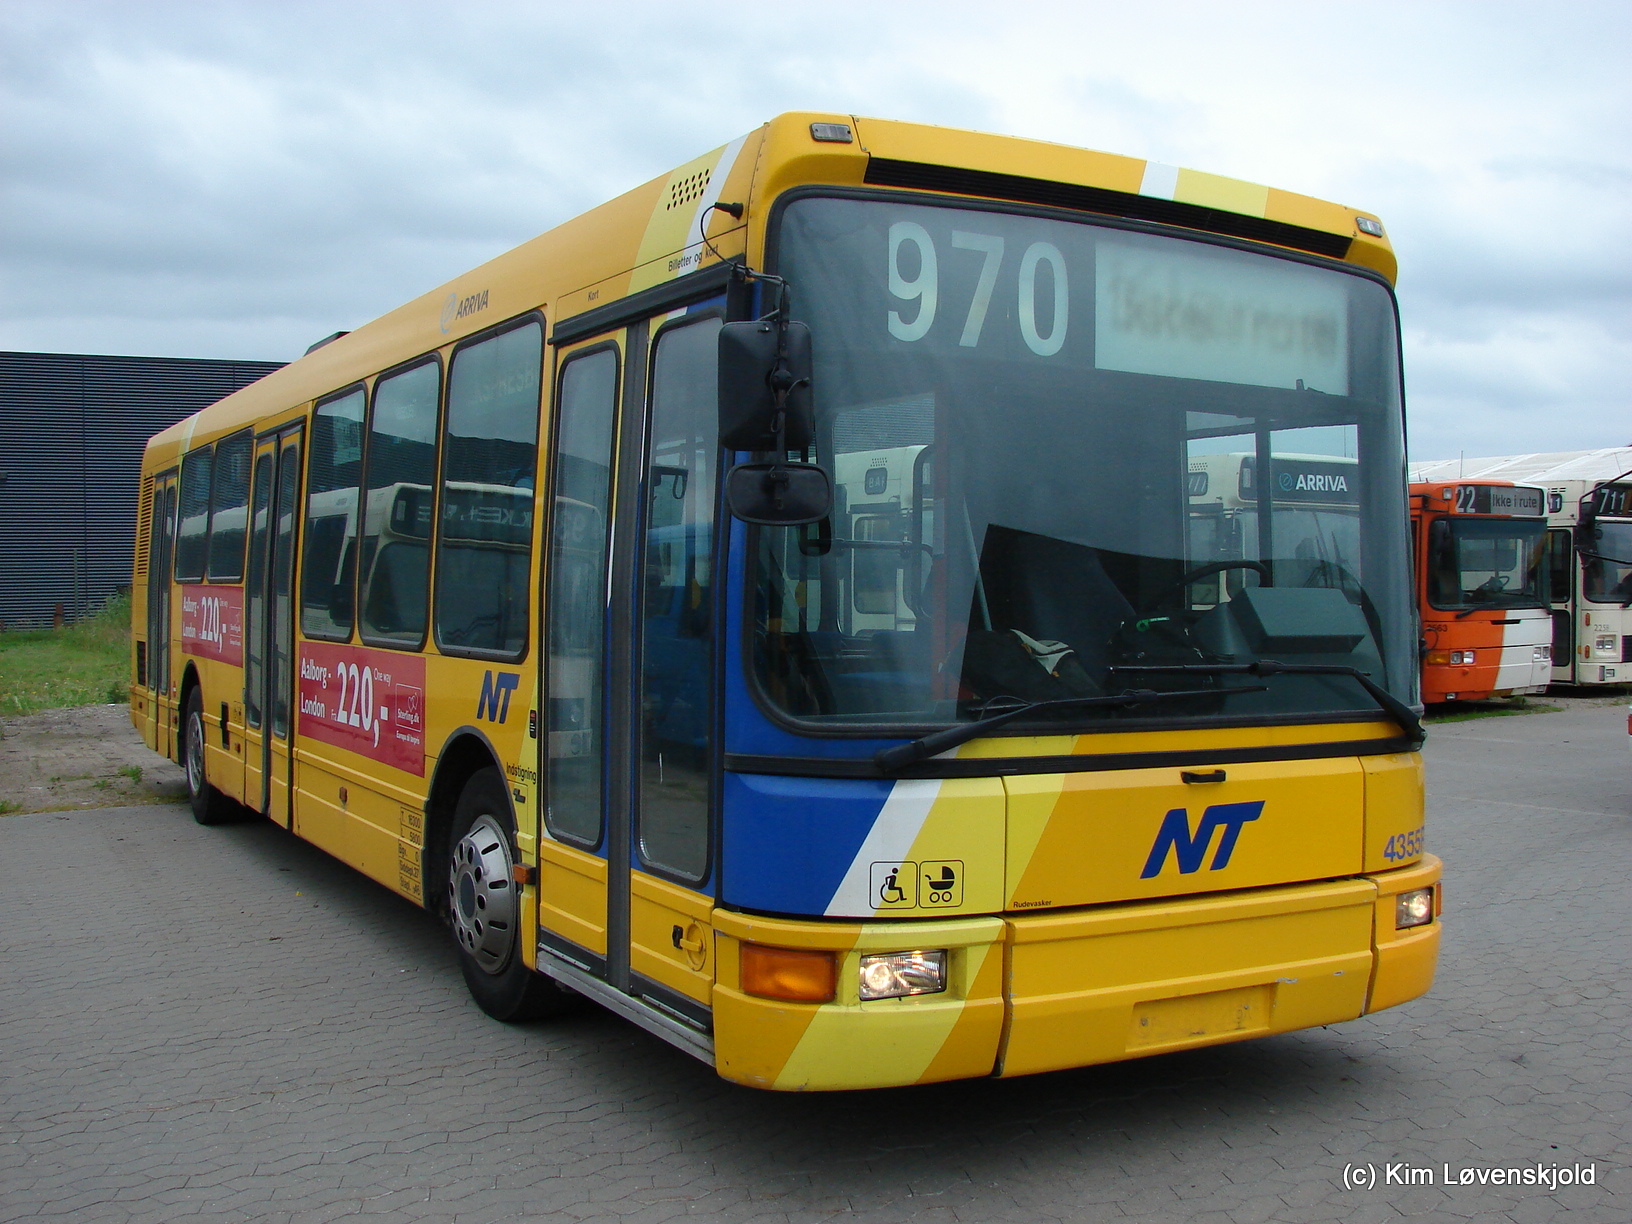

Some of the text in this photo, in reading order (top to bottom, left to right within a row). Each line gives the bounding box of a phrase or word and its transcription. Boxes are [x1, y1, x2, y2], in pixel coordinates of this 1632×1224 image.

[668, 255, 692, 272] Billetter
[694, 251, 703, 265] og
[887, 221, 1070, 357] 970
[455, 289, 489, 320] ARRIVA
[1296, 474, 1348, 492] ARRIVA
[1455, 486, 1538, 513] 22 Ikke i rute
[1599, 488, 1626, 514] 711
[183, 596, 197, 618] Aalborg
[182, 621, 197, 639] London
[301, 657, 327, 689] Aalborg
[373, 667, 392, 687] One way
[301, 691, 326, 719] London
[476, 670, 520, 725] NT
[506, 761, 537, 785] Indstigning
[1140, 800, 1266, 879] NT
[1013, 899, 1053, 909] Rudevasker
